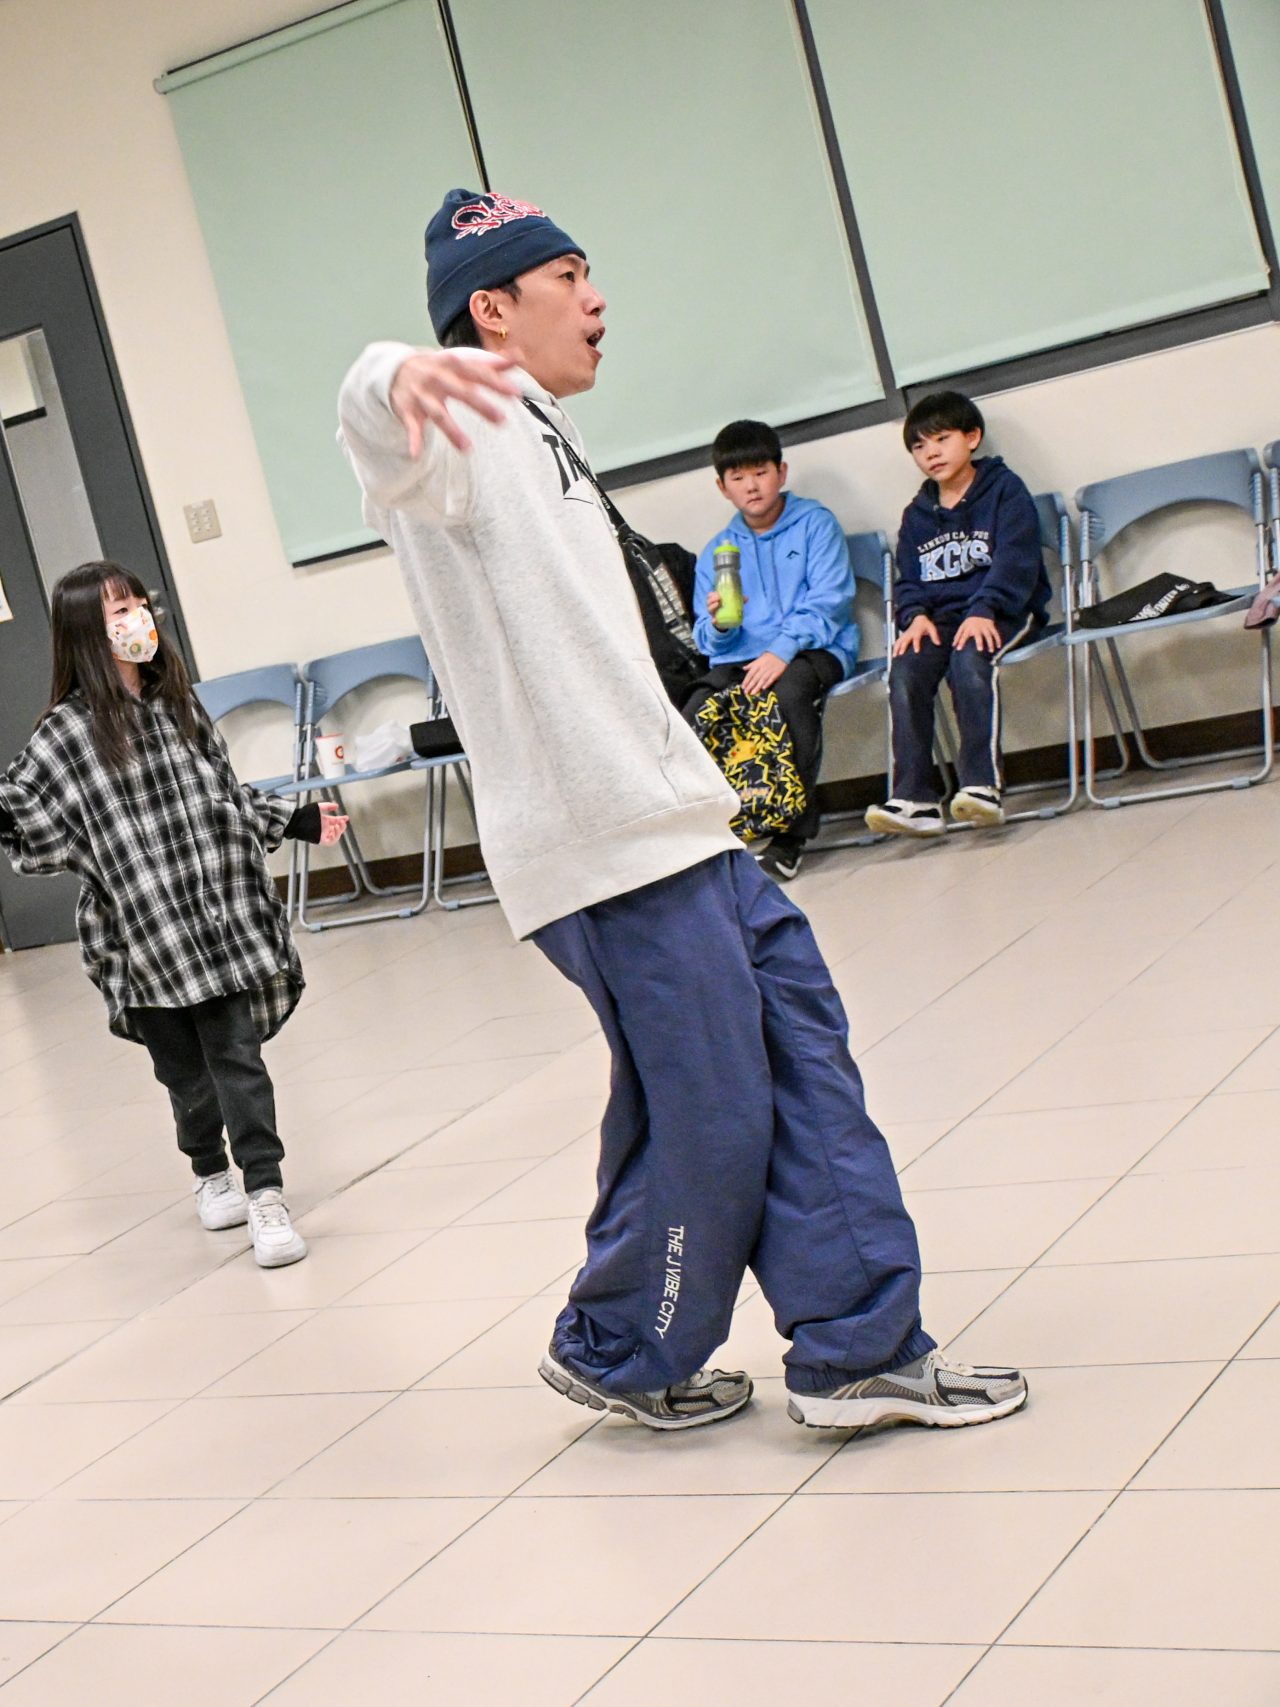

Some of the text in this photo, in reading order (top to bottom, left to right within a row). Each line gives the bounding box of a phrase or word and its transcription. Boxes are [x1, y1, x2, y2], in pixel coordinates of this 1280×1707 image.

[917, 530, 989, 554] LINKOU CAPUS
[919, 539, 992, 582] KCIS
[654, 1225, 685, 1340] THE J VIBE CITY
